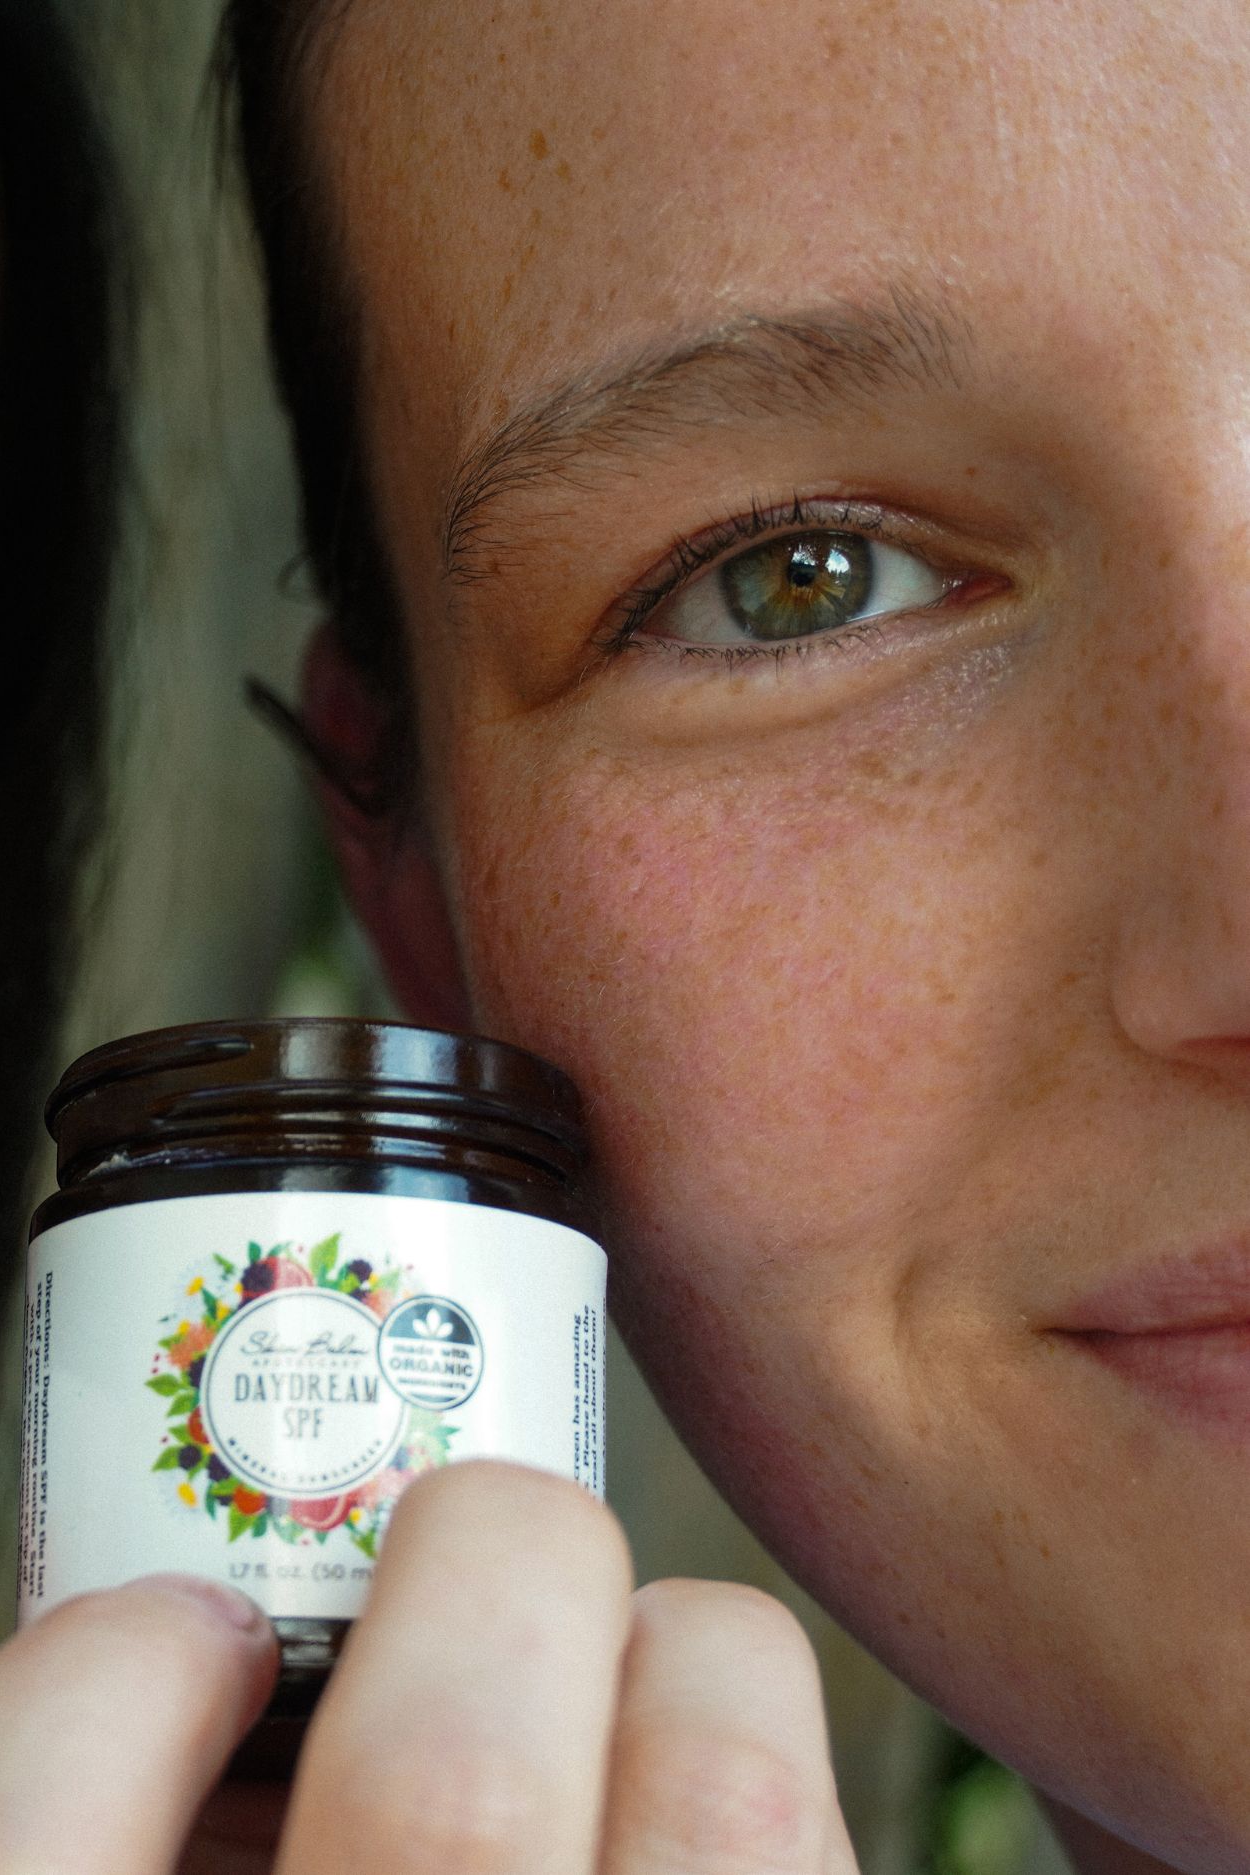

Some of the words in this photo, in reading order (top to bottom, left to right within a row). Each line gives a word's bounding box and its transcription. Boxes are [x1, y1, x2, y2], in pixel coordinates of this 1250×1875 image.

[36, 1324, 41, 1341] of
[43, 1271, 52, 1368] Directions:
[393, 1344, 434, 1356] made
[442, 1347, 470, 1359] with
[572, 1313, 580, 1388] amazing
[584, 1339, 588, 1356] to
[389, 1358, 473, 1378] ORGANIC
[234, 1373, 380, 1404] DAYDREAM
[40, 1374, 49, 1464] Daydream
[283, 1406, 323, 1439] SPF
[572, 1394, 580, 1424] has
[39, 1510, 46, 1524] is
[37, 1565, 45, 1597] last
[311, 1563, 346, 1582] (50
